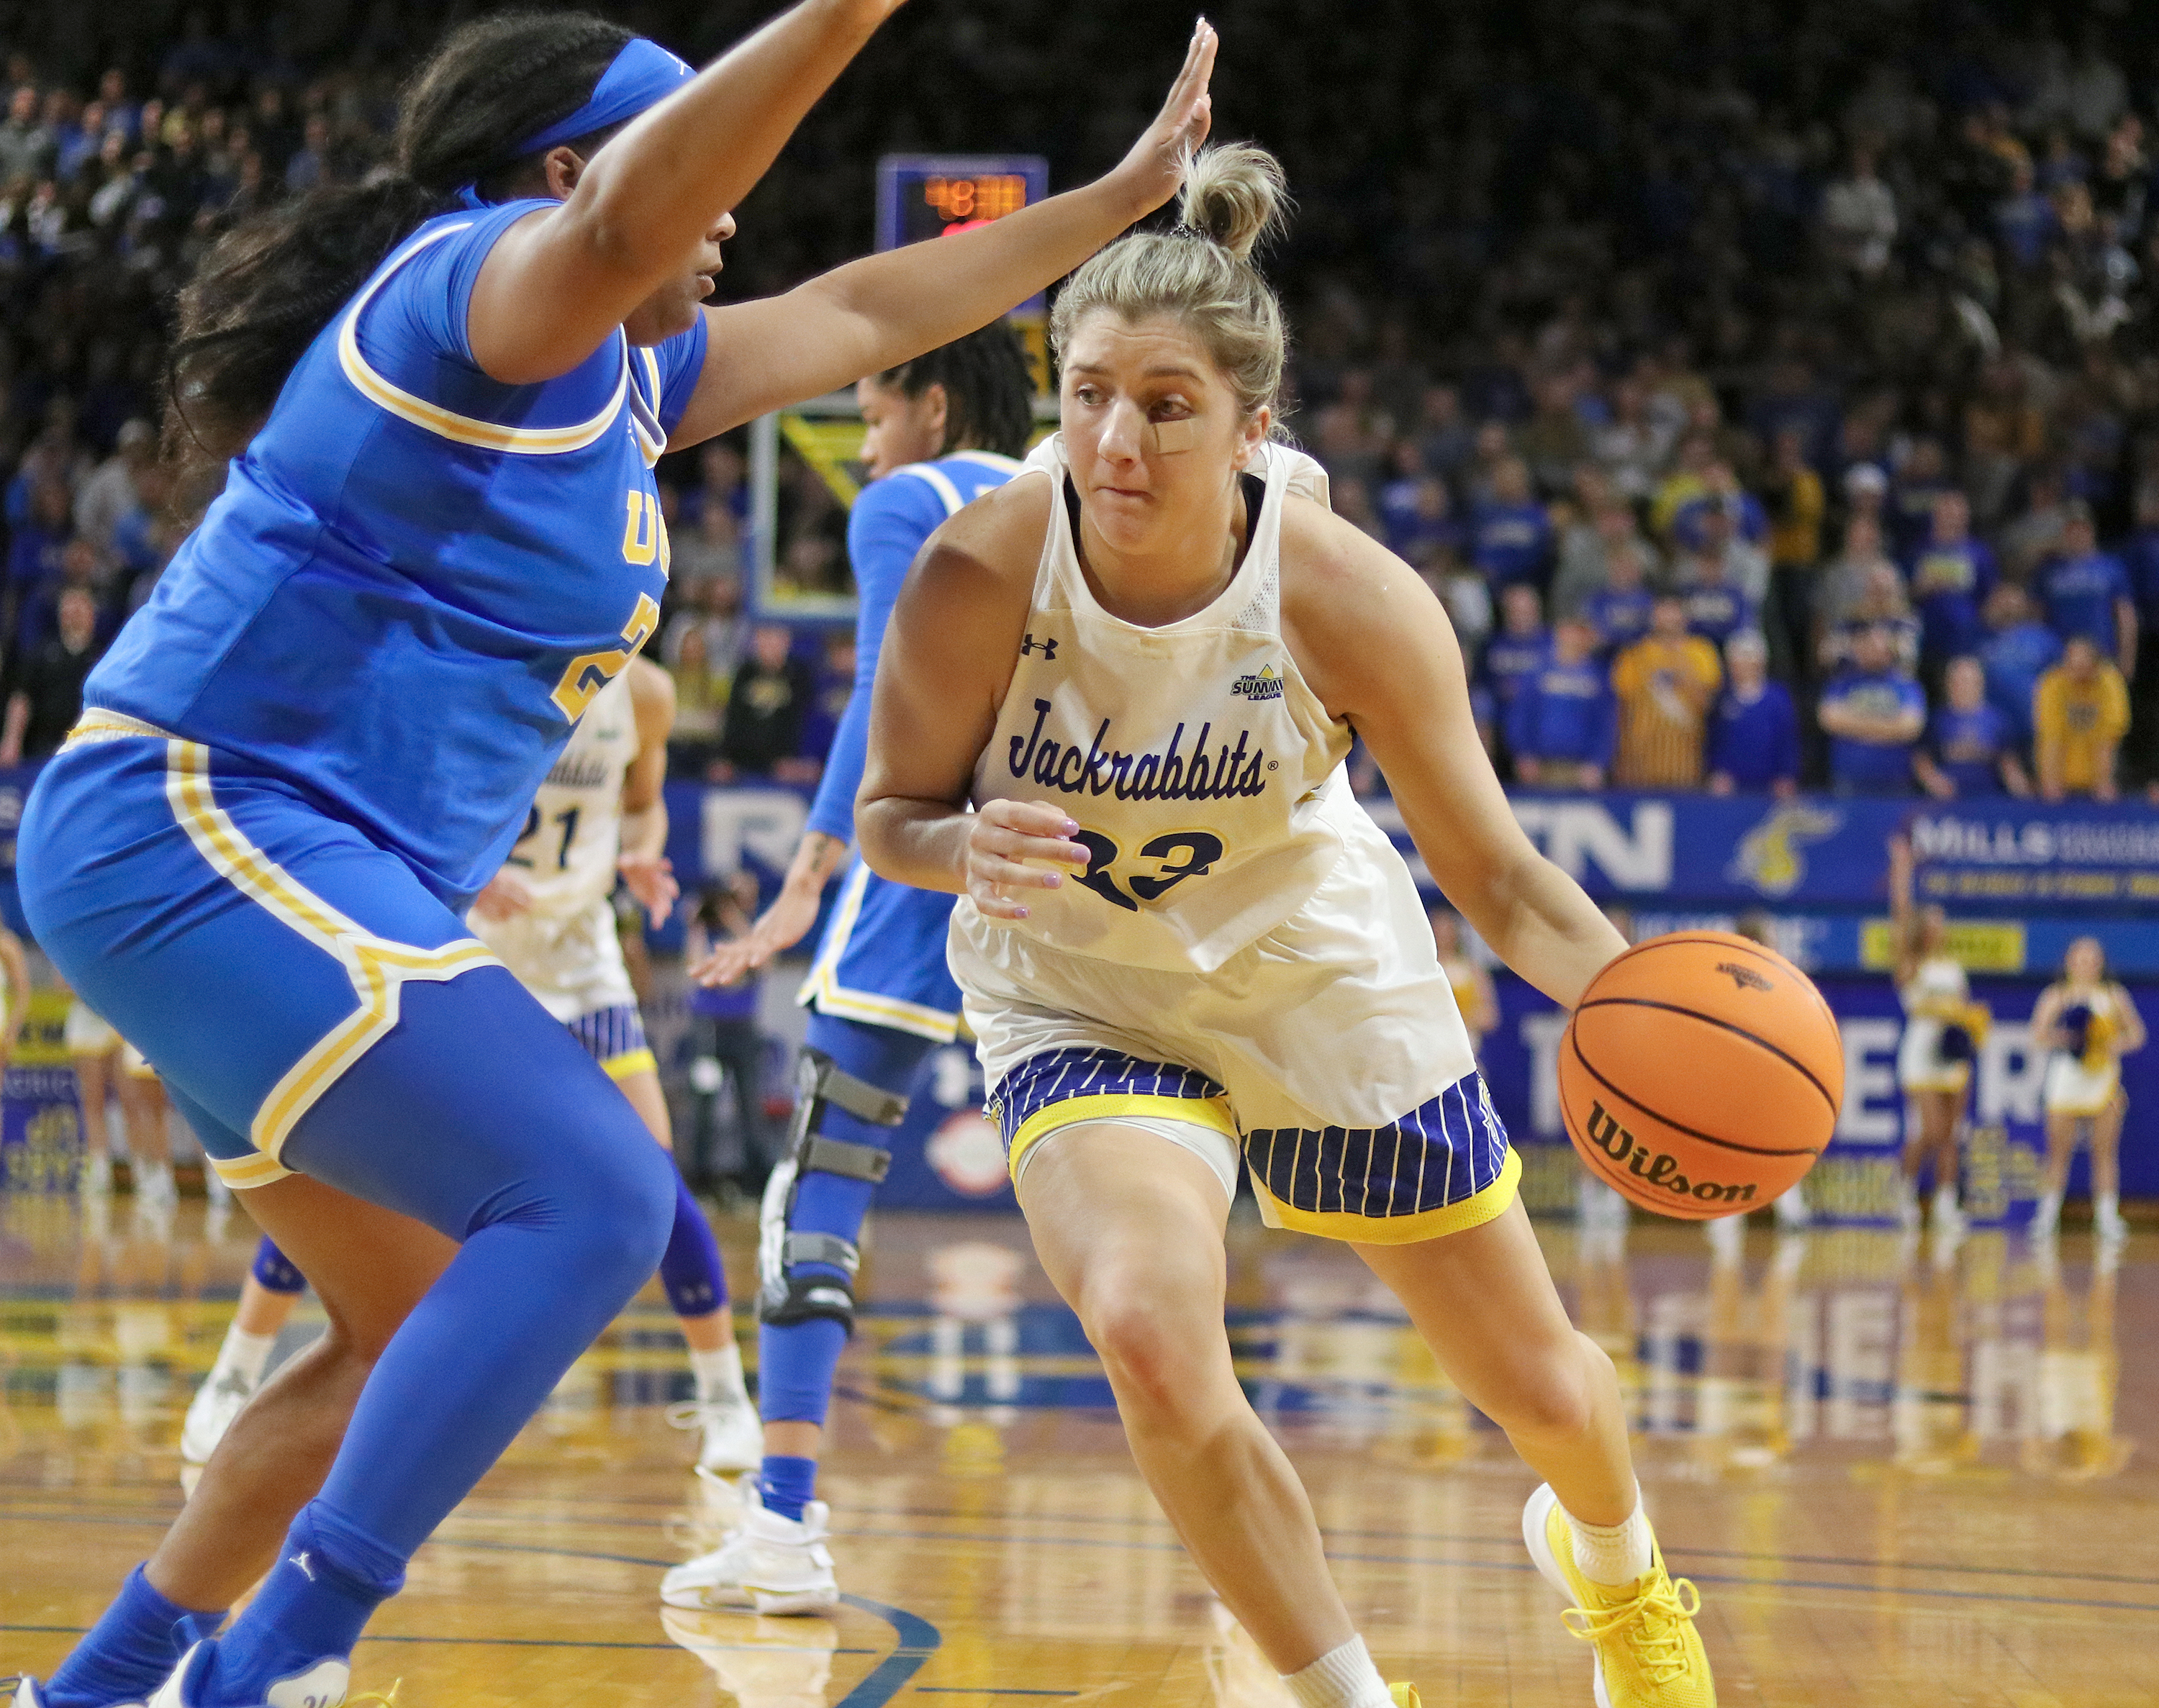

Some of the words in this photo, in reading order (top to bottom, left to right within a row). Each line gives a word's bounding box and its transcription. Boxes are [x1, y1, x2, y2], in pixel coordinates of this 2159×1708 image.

[1230, 678, 1284, 696] SUMMI
[1009, 698, 1265, 801] Jackrabbits
[1587, 1099, 1757, 1202] Wilson
